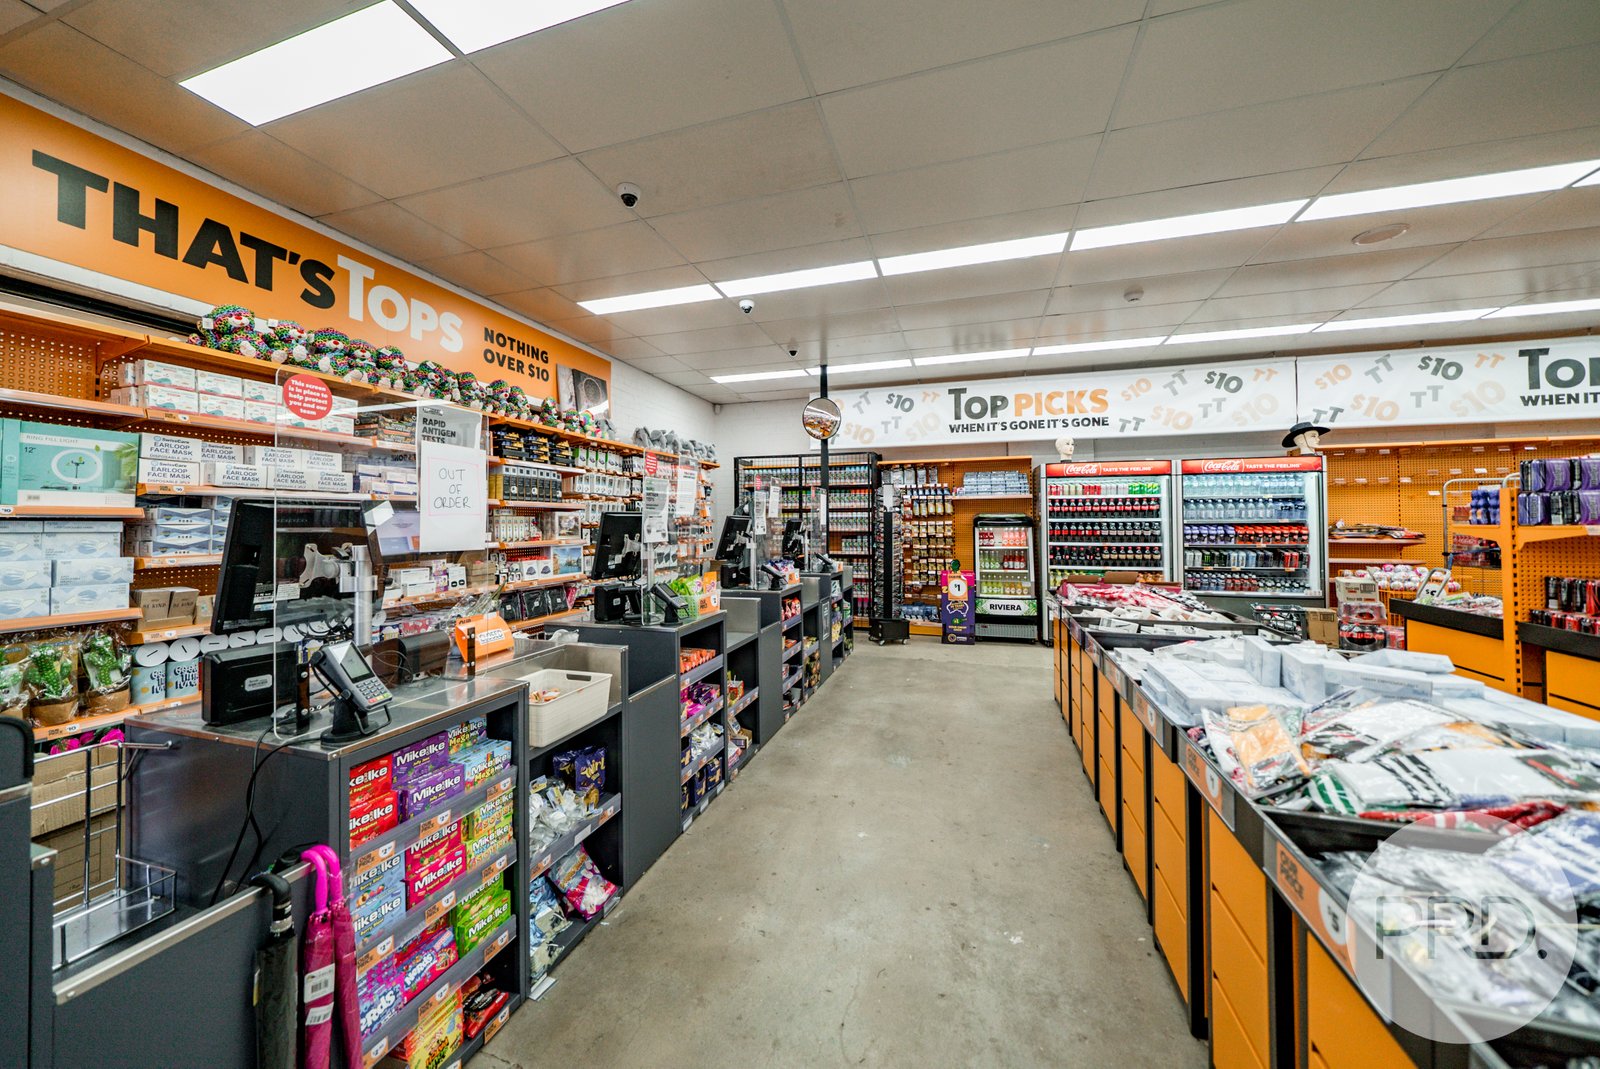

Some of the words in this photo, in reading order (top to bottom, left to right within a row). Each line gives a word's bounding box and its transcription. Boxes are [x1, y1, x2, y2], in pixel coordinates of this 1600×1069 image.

[32, 150, 336, 310] THAT'S
[484, 327, 549, 364] NOTHING
[483, 348, 525, 375] OVER
[528, 363, 550, 382] $10
[1417, 355, 1464, 381] $10
[291, 379, 304, 387] This
[306, 384, 326, 392] screen
[1204, 370, 1244, 394] $10
[1314, 364, 1352, 390] $10
[288, 392, 304, 400] help
[304, 396, 328, 404] protect
[1120, 377, 1153, 401] $10
[886, 392, 915, 413] $10
[1014, 389, 1109, 417] PICKS
[1350, 393, 1400, 422] $10
[1449, 380, 1506, 418] $10
[1520, 392, 1580, 407] WHEN
[1151, 404, 1194, 431] $10
[1231, 393, 1280, 427] $10
[422, 418, 446, 428] RAPID
[422, 426, 456, 438] ANTIGEN
[949, 422, 985, 433] WHEN
[987, 421, 1008, 432] IT'S
[1009, 419, 1045, 430] GONE
[1047, 418, 1069, 428] IT'S
[1071, 416, 1110, 428] GONE
[844, 422, 876, 445] $10
[154, 442, 190, 450] EARLOOP
[438, 467, 466, 481] OUT
[1066, 464, 1098, 474] Coca-Cola
[1204, 460, 1240, 472] Coca-Cola
[448, 484, 463, 495] OF
[434, 496, 472, 510] ORDER
[954, 584, 960, 592] $1
[349, 813, 370, 830] ike
